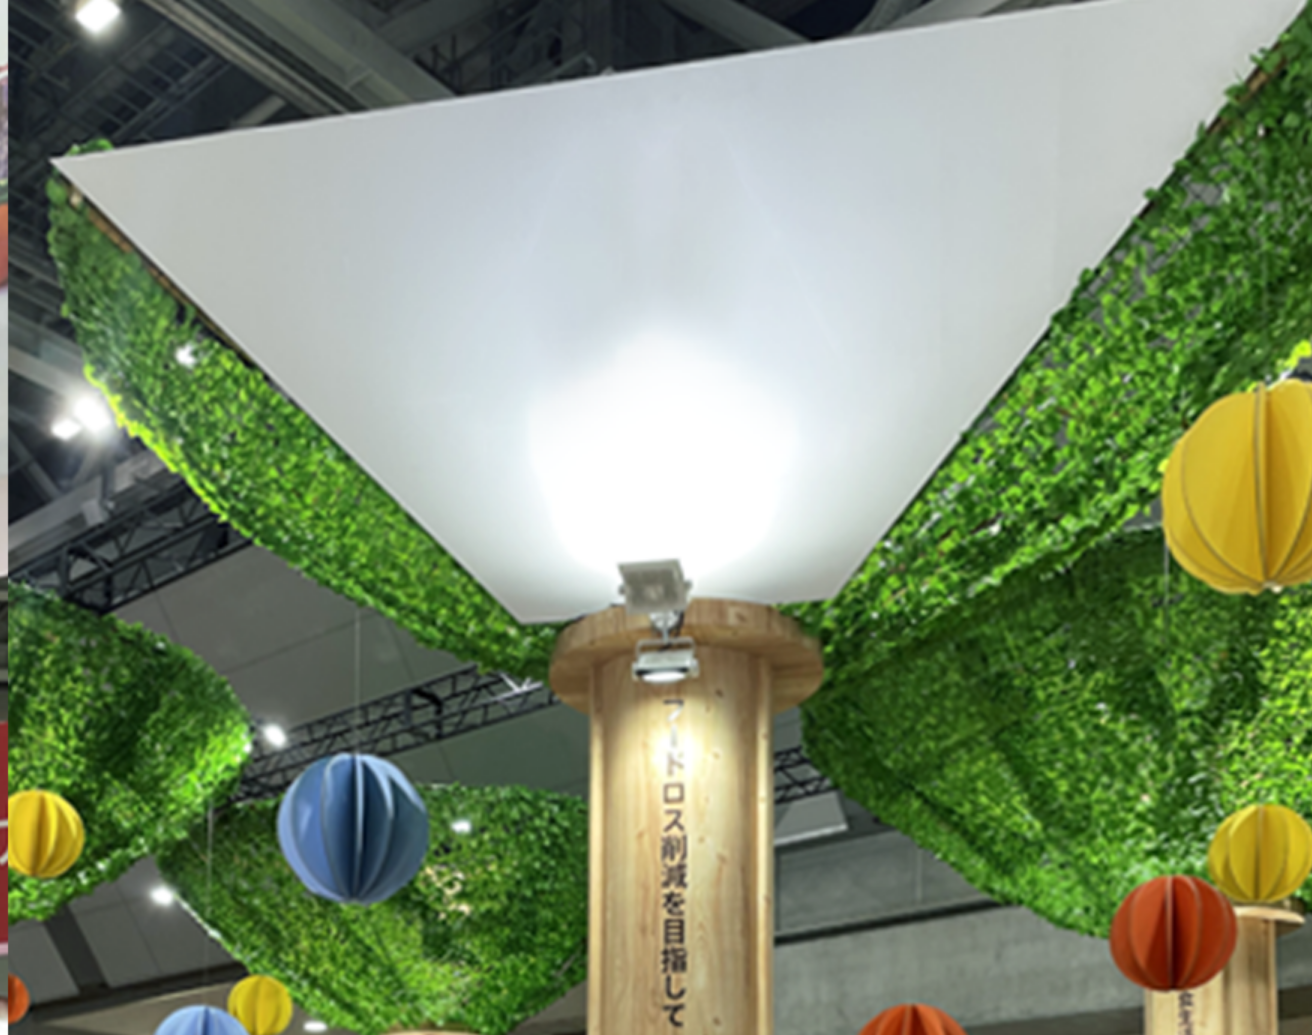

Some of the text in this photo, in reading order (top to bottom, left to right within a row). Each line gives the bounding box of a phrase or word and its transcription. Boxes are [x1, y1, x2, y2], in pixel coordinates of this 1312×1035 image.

[658, 699, 690, 1029] フードロス削減を目指して
